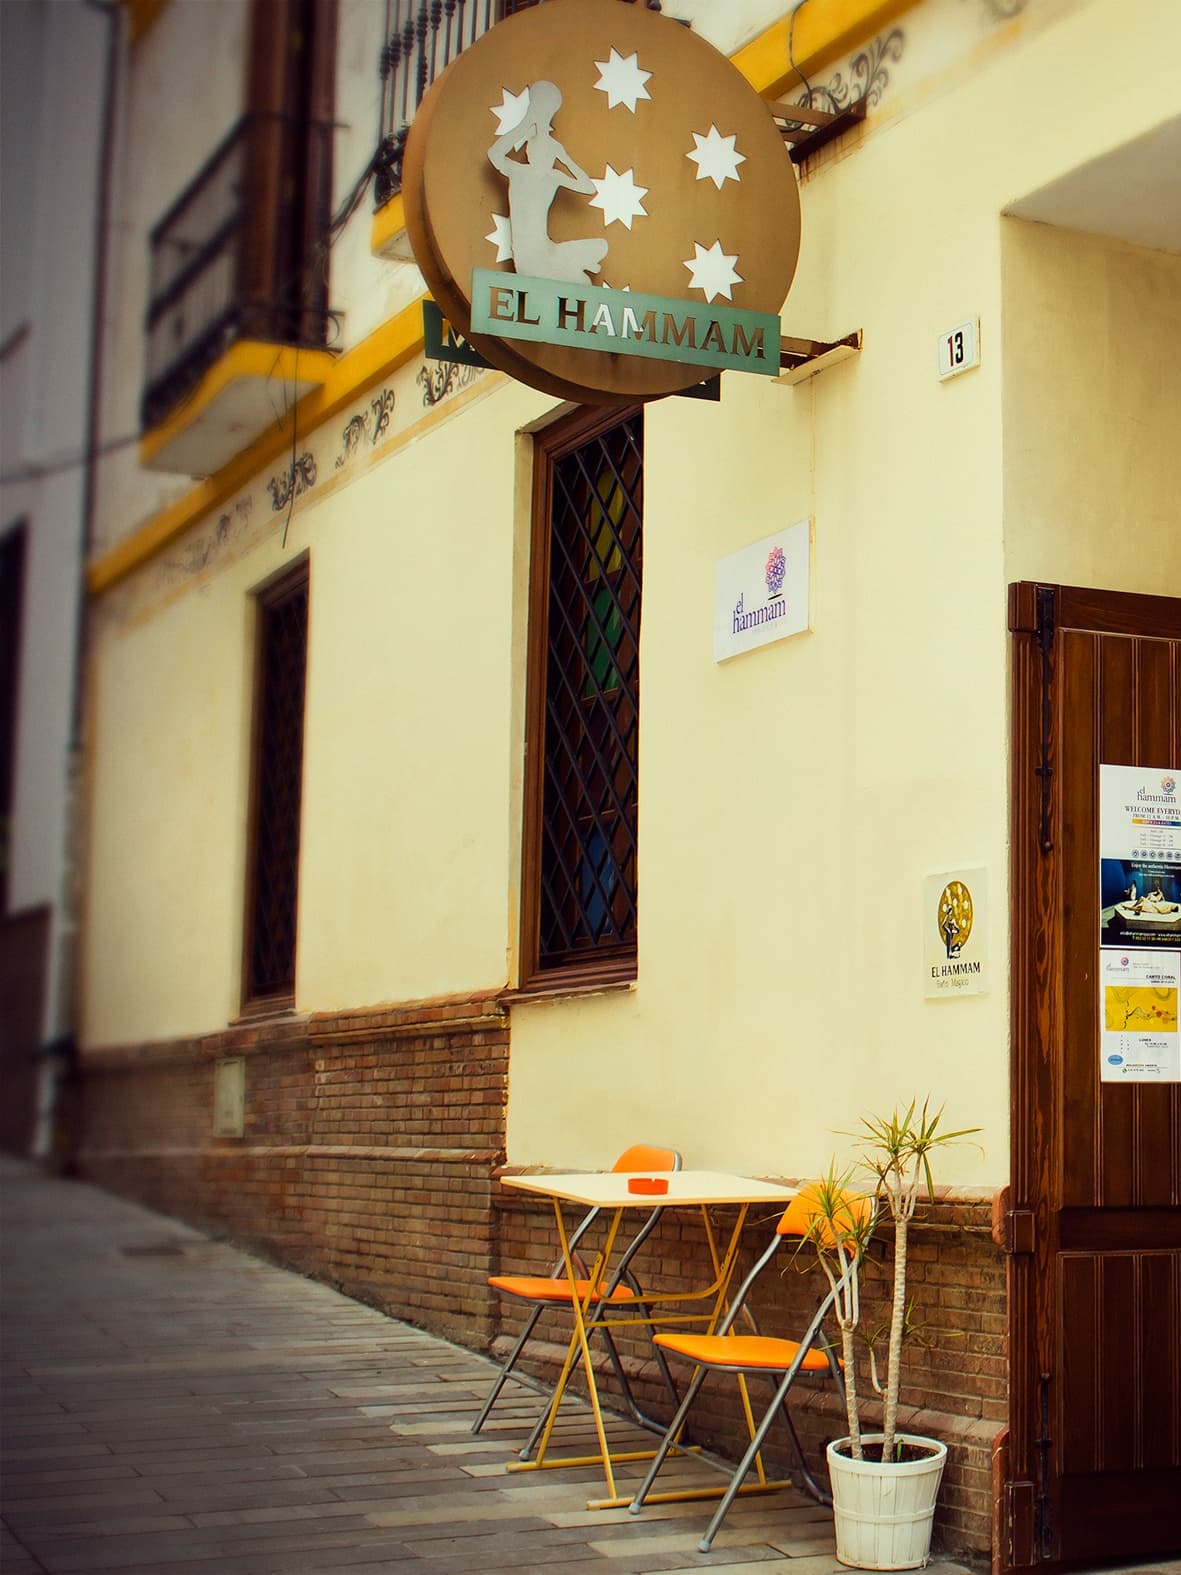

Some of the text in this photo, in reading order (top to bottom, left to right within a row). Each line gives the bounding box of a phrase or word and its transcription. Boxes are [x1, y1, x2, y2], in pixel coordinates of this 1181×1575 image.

[487, 285, 767, 360] EL HAMMAM
[947, 331, 964, 367] 13
[735, 592, 744, 614] el
[732, 600, 787, 634] hammam
[1137, 792, 1176, 803] hammam
[1125, 806, 1154, 814] WELCOME
[931, 962, 981, 978] EL HAMMAM
